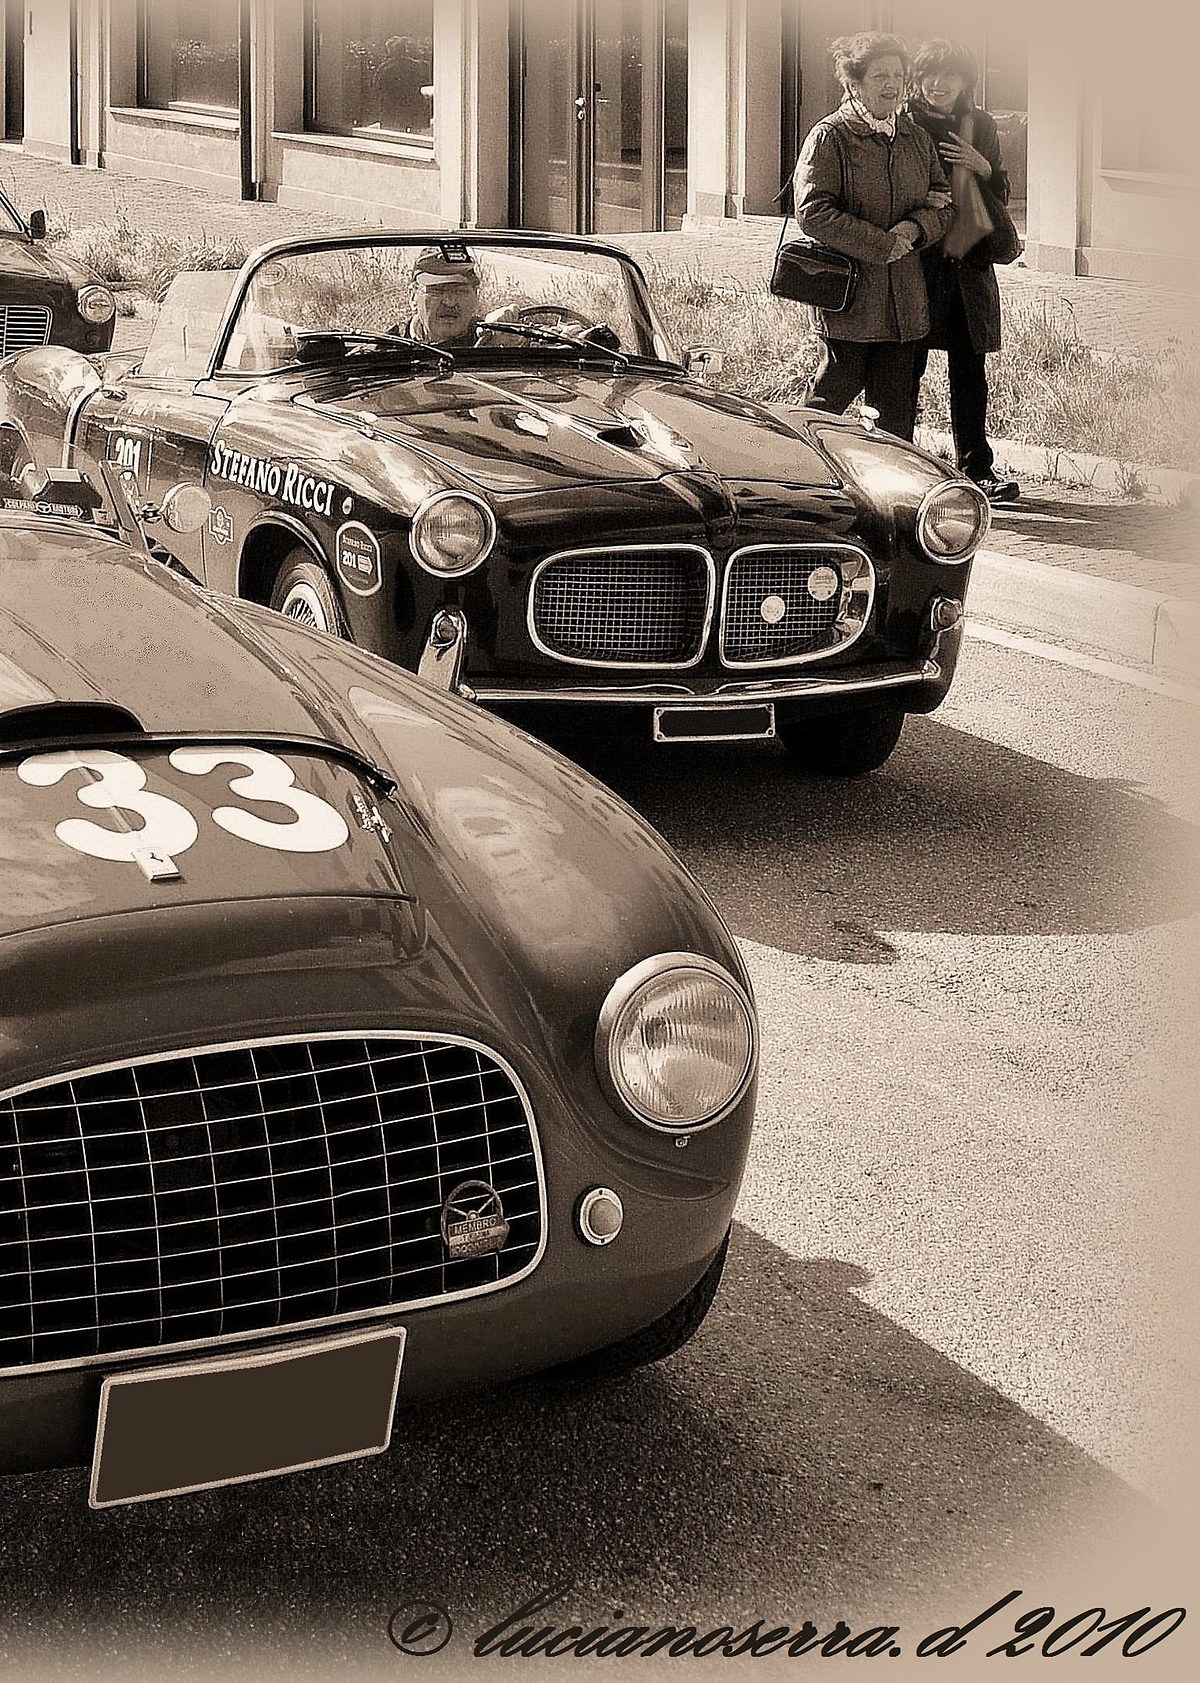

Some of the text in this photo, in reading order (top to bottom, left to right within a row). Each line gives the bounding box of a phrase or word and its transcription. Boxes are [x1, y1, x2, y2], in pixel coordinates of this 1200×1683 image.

[115, 437, 142, 479] 201
[211, 440, 335, 516] STEFANO RICCI
